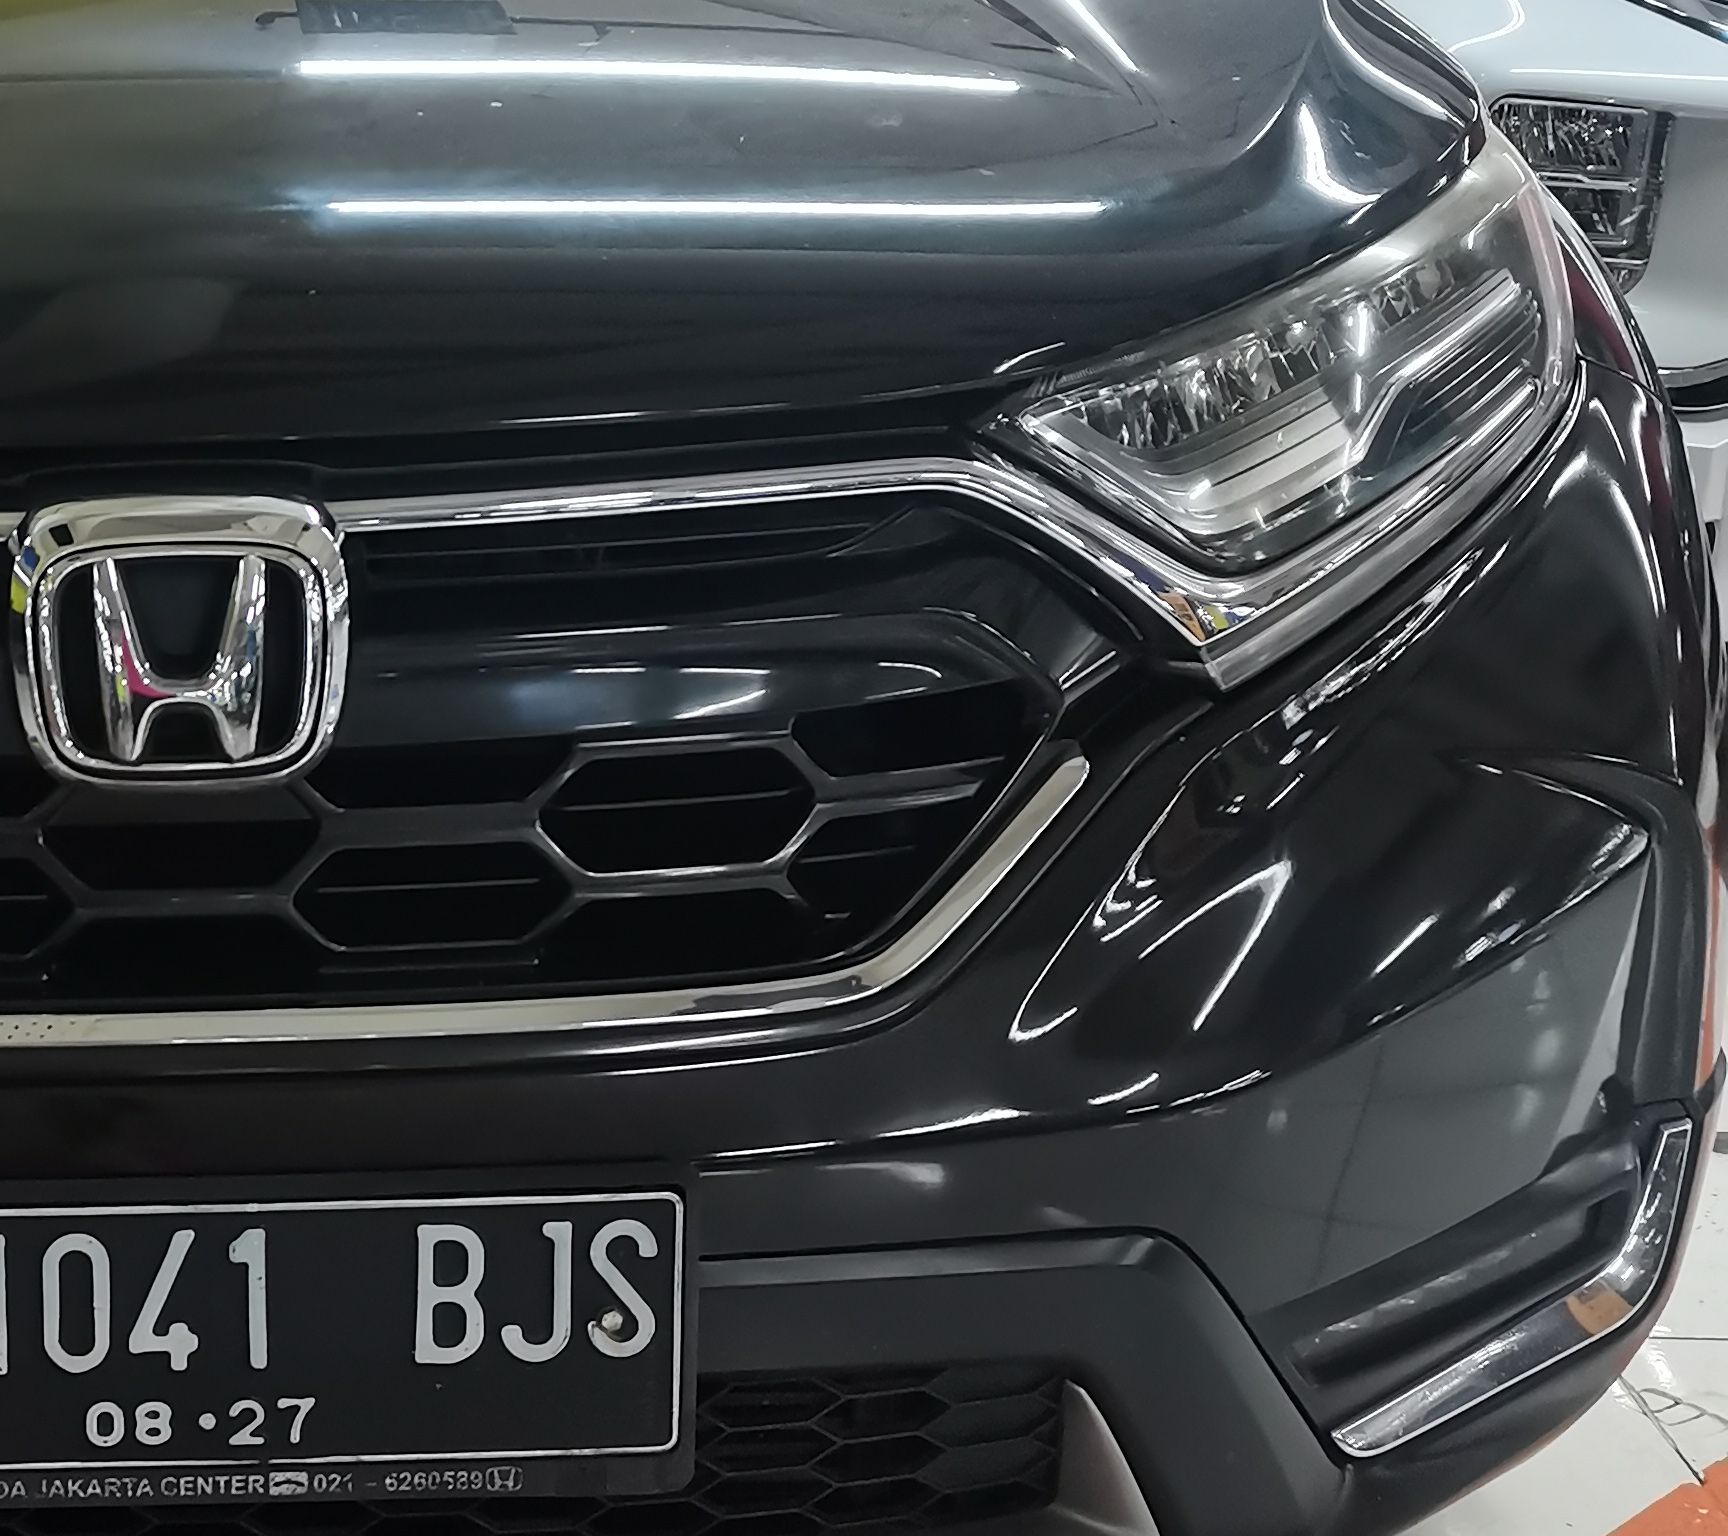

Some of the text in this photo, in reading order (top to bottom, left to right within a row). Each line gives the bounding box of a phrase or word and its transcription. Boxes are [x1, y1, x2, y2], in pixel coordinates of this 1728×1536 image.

[413, 1219, 659, 1366] BJS
[36, 1477, 154, 1498] JAKARTA
[160, 1474, 265, 1496] CENTER
[313, 1472, 353, 1493] 021
